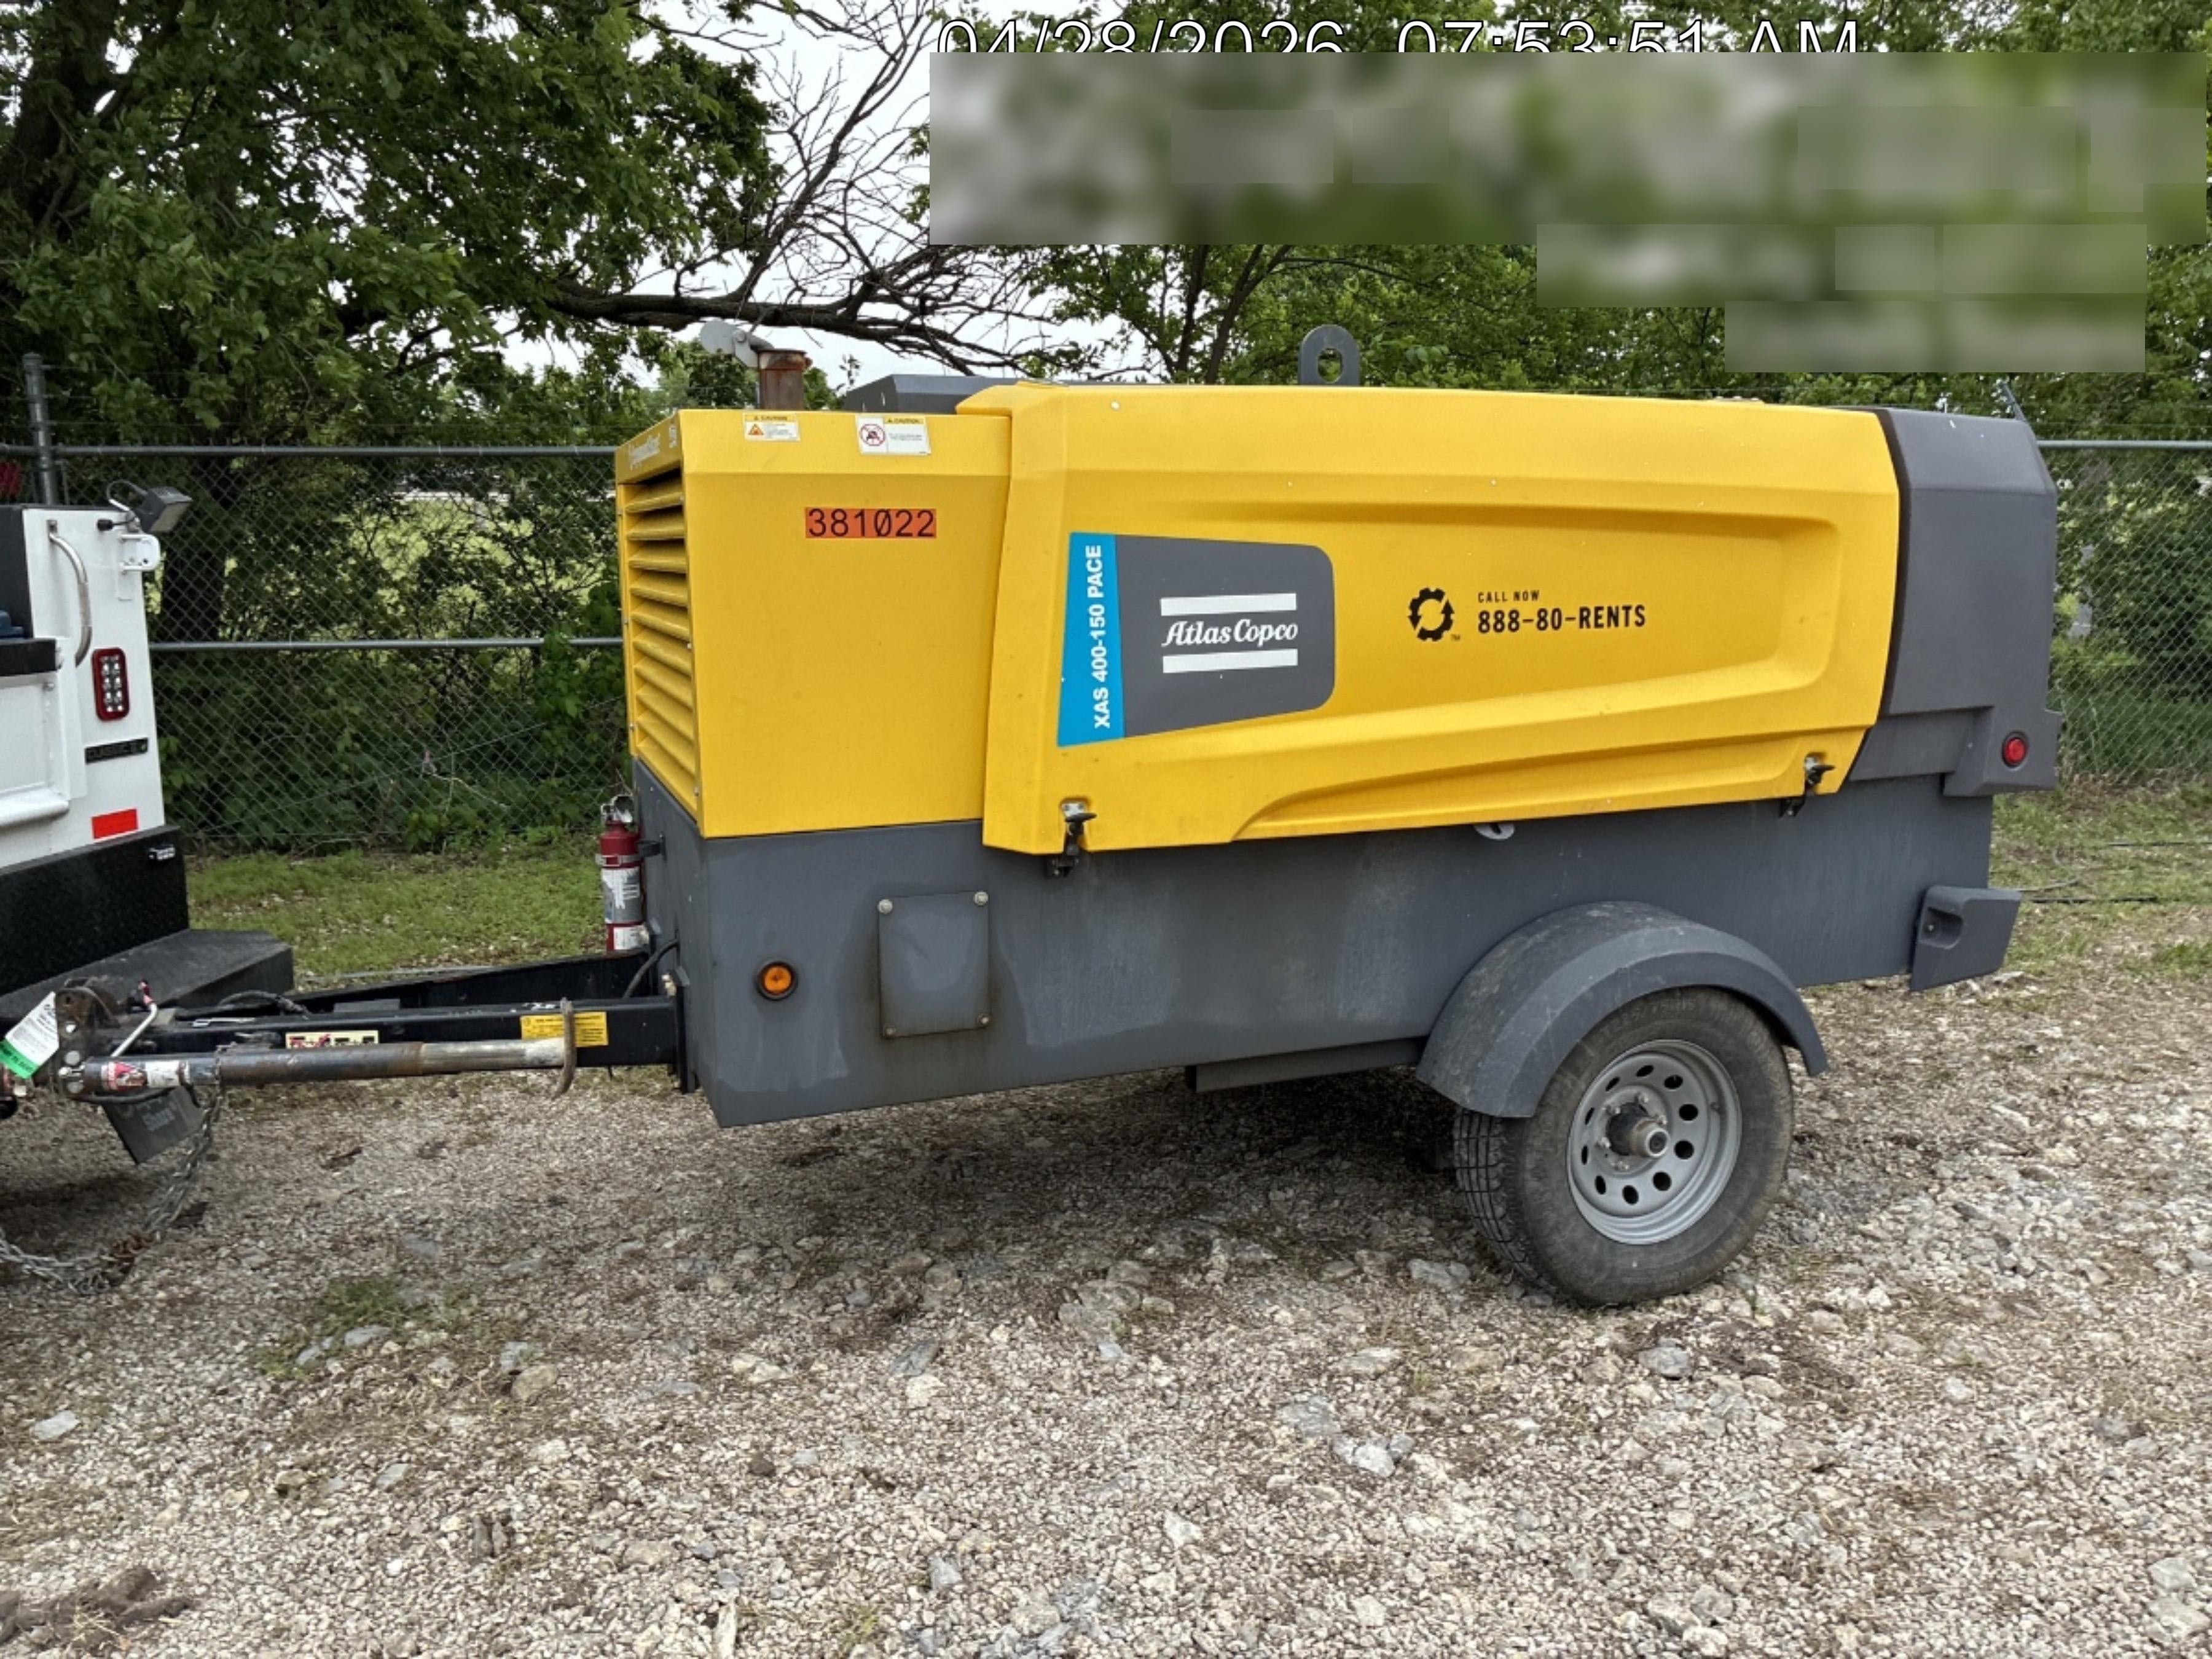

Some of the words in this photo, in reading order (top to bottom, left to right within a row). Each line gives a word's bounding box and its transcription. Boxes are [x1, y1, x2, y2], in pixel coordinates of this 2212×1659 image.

[808, 508, 935, 537] 381022
[1085, 544, 1104, 598] PACE
[1477, 591, 1508, 603] CALL
[1513, 590, 1540, 602] NOW
[1161, 621, 1232, 648] Atlas
[1233, 618, 1298, 648] Copco
[1477, 604, 1646, 634] 888-80-RENTS
[1088, 603, 1108, 683] 400-150
[1093, 686, 1110, 729] XAS
